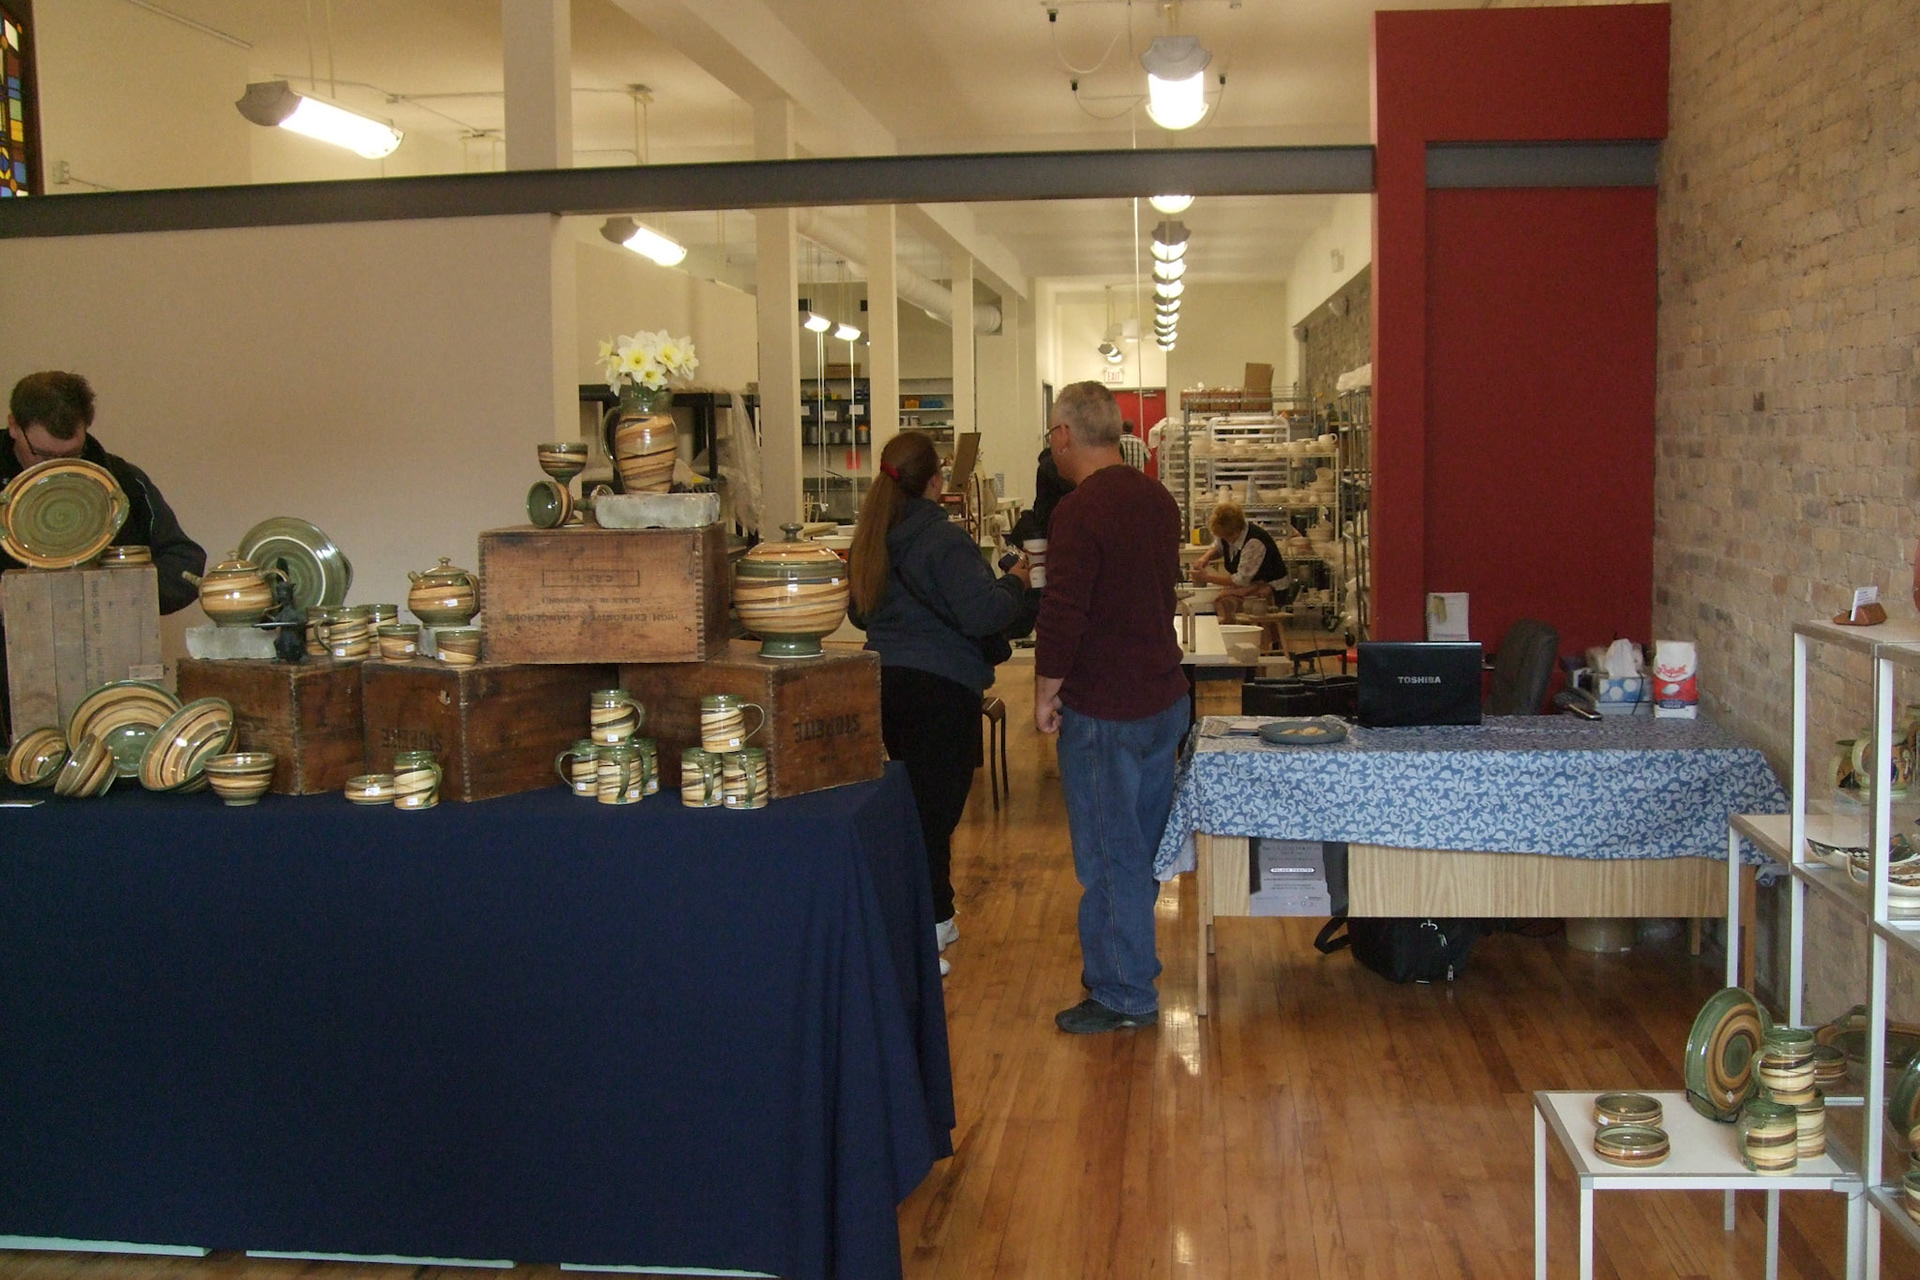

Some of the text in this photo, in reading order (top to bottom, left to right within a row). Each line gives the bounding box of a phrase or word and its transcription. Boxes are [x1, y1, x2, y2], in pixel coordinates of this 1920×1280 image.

[1107, 371, 1120, 381] EXIT
[506, 613, 570, 622] DANGEROUS
[652, 613, 679, 623] HIGH
[93, 622, 102, 635] UP
[1397, 675, 1442, 684] TOSHIBA
